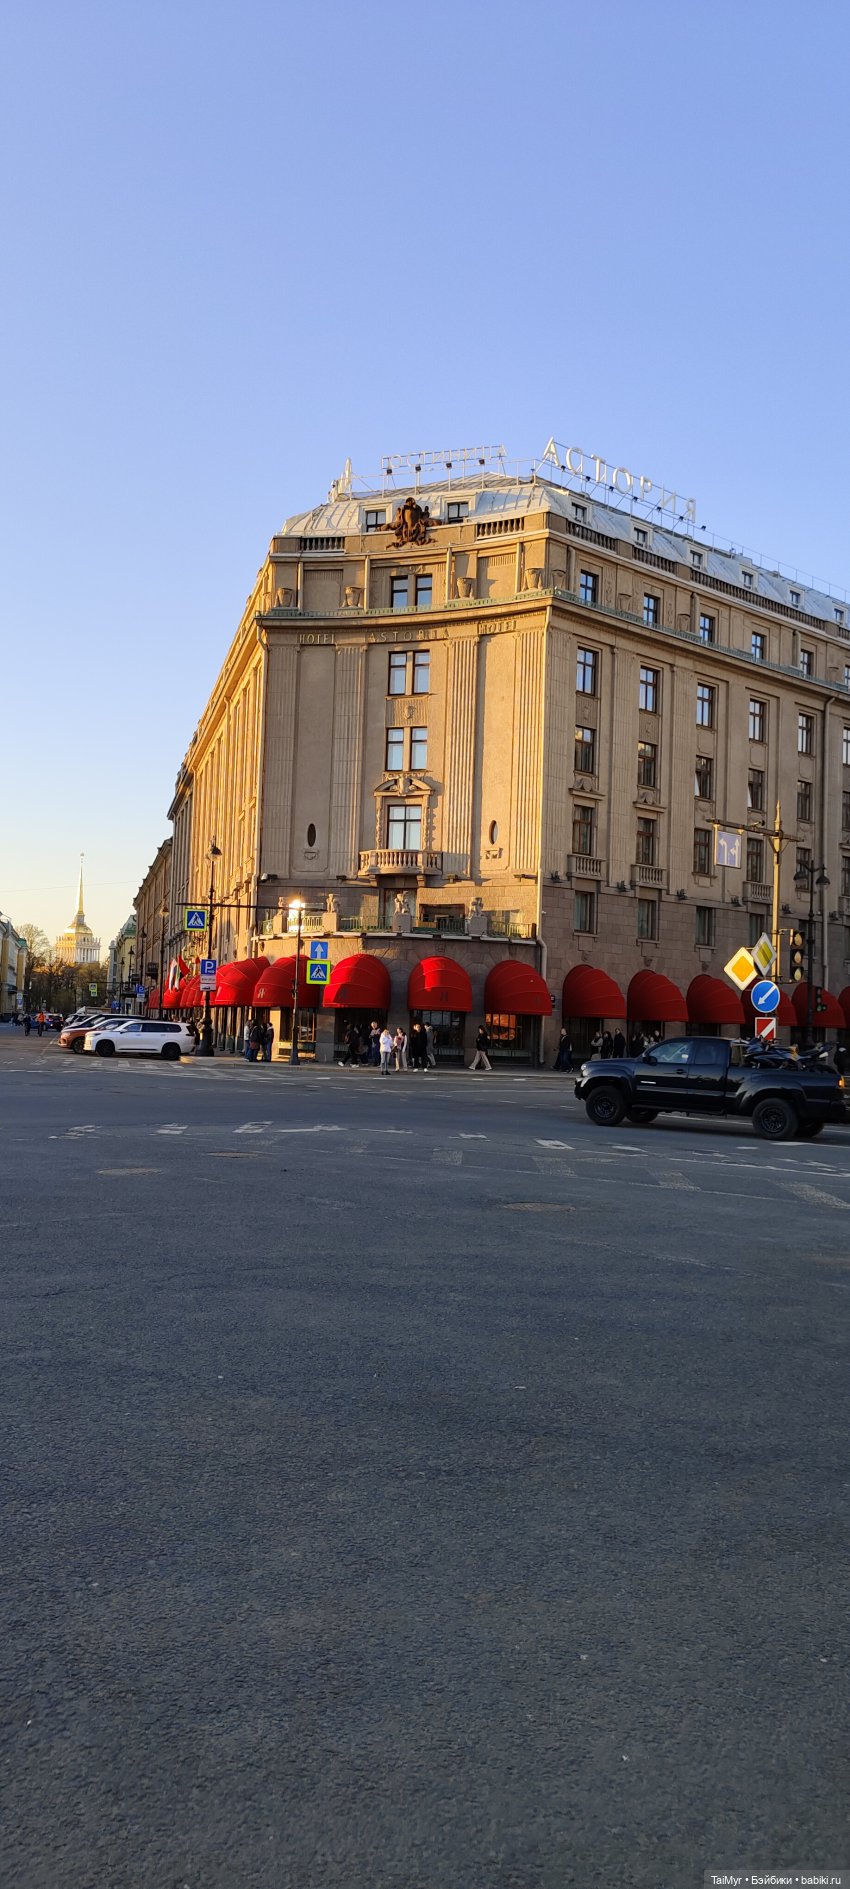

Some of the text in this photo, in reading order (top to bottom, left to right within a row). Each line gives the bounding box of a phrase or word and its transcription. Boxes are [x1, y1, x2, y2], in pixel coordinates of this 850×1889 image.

[543, 436, 697, 524] АСТОРИЯ
[299, 633, 334, 645] HOTEL
[368, 628, 449, 643] ASTORIA
[204, 960, 214, 973] P
